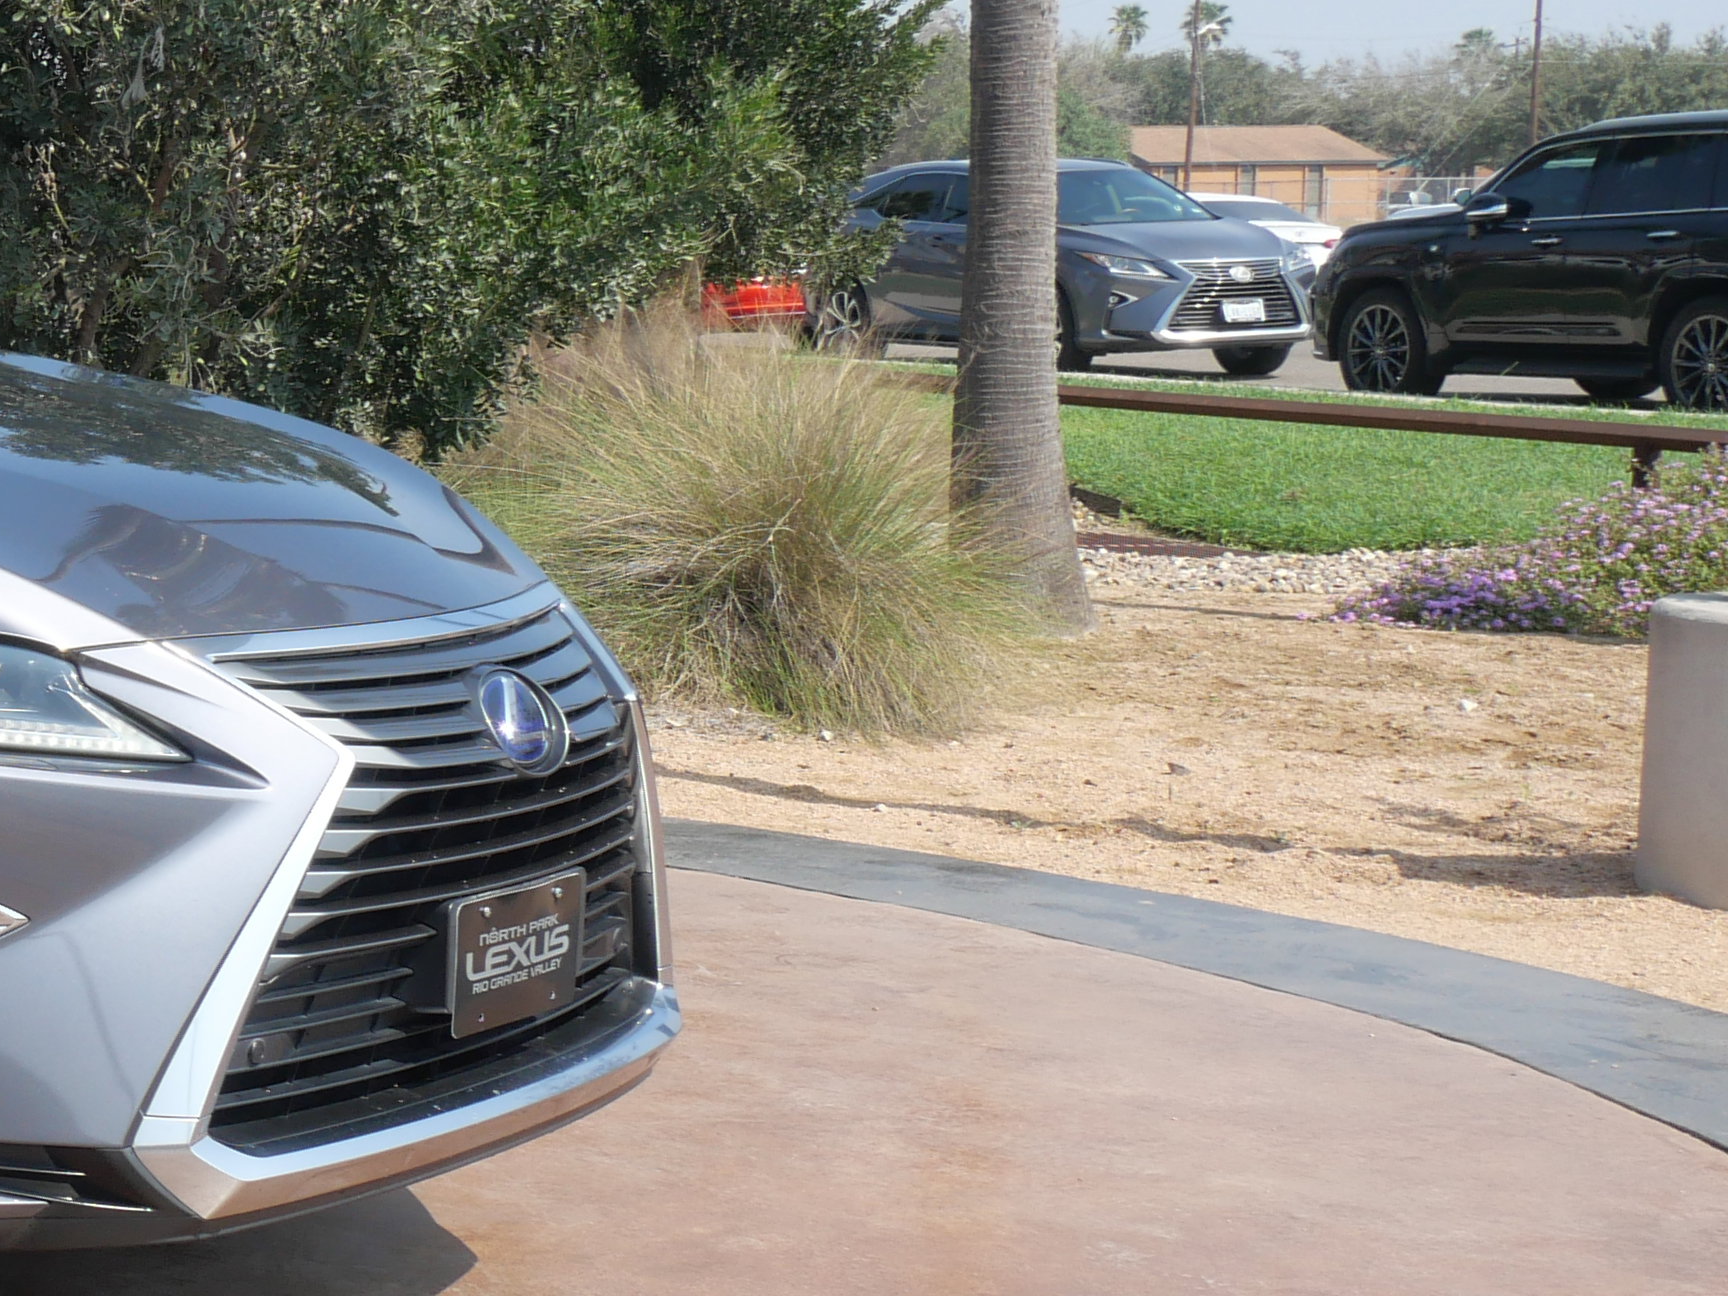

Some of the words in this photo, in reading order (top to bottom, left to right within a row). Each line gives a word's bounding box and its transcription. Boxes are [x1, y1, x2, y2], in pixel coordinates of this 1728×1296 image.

[479, 924, 527, 946] NORTH
[529, 913, 559, 934] PARK
[466, 924, 569, 981] LEXUS
[472, 980, 489, 995] RIO
[490, 969, 529, 989] GRANDE
[530, 957, 562, 977] VALLEY
